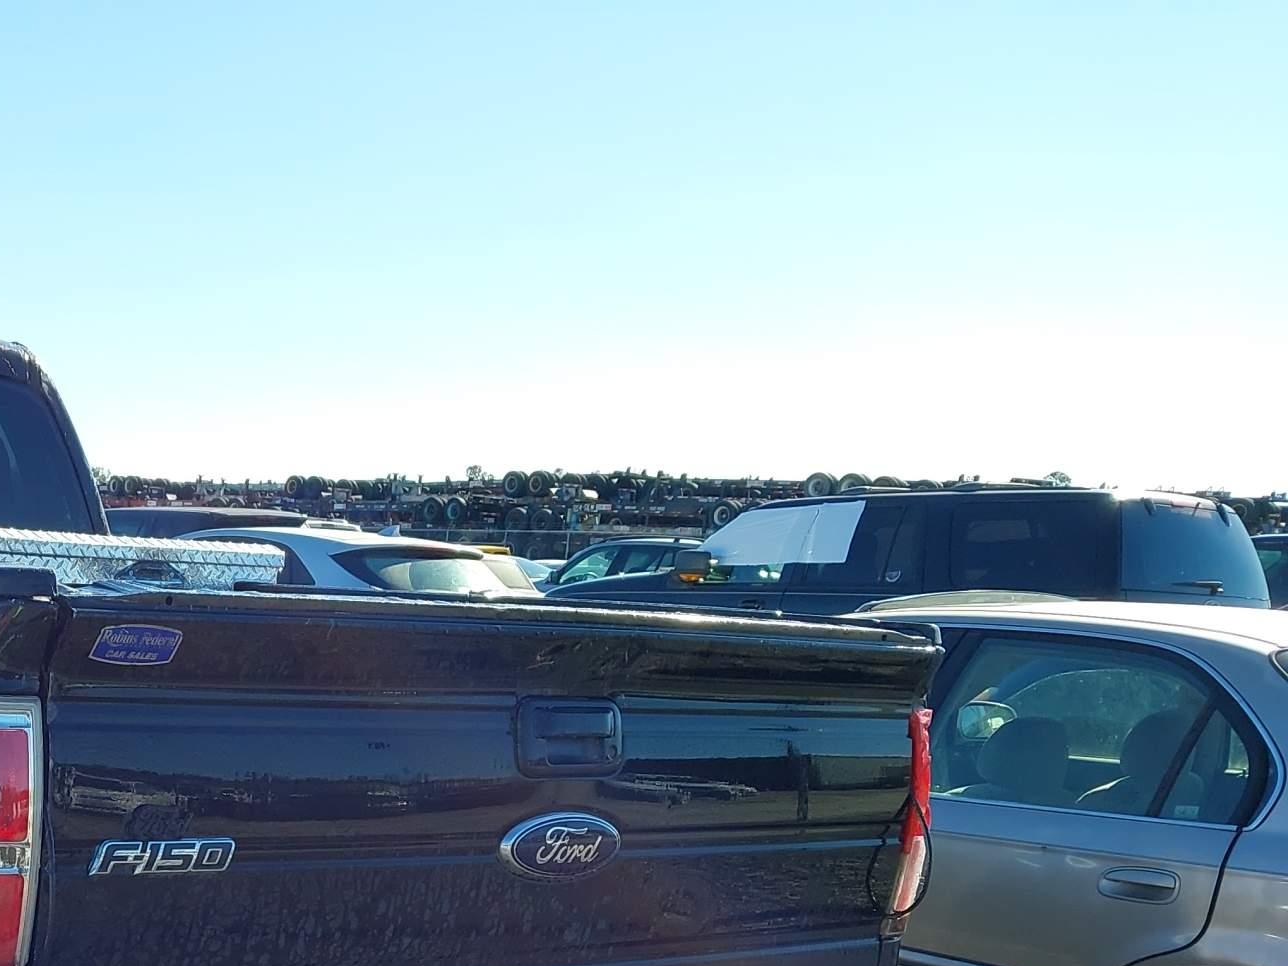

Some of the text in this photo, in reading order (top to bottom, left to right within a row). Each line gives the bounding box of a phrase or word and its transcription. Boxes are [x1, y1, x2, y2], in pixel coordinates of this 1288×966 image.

[105, 649, 158, 660] CAR SALES
[88, 838, 236, 876] F-150
[535, 826, 602, 865] Ford
